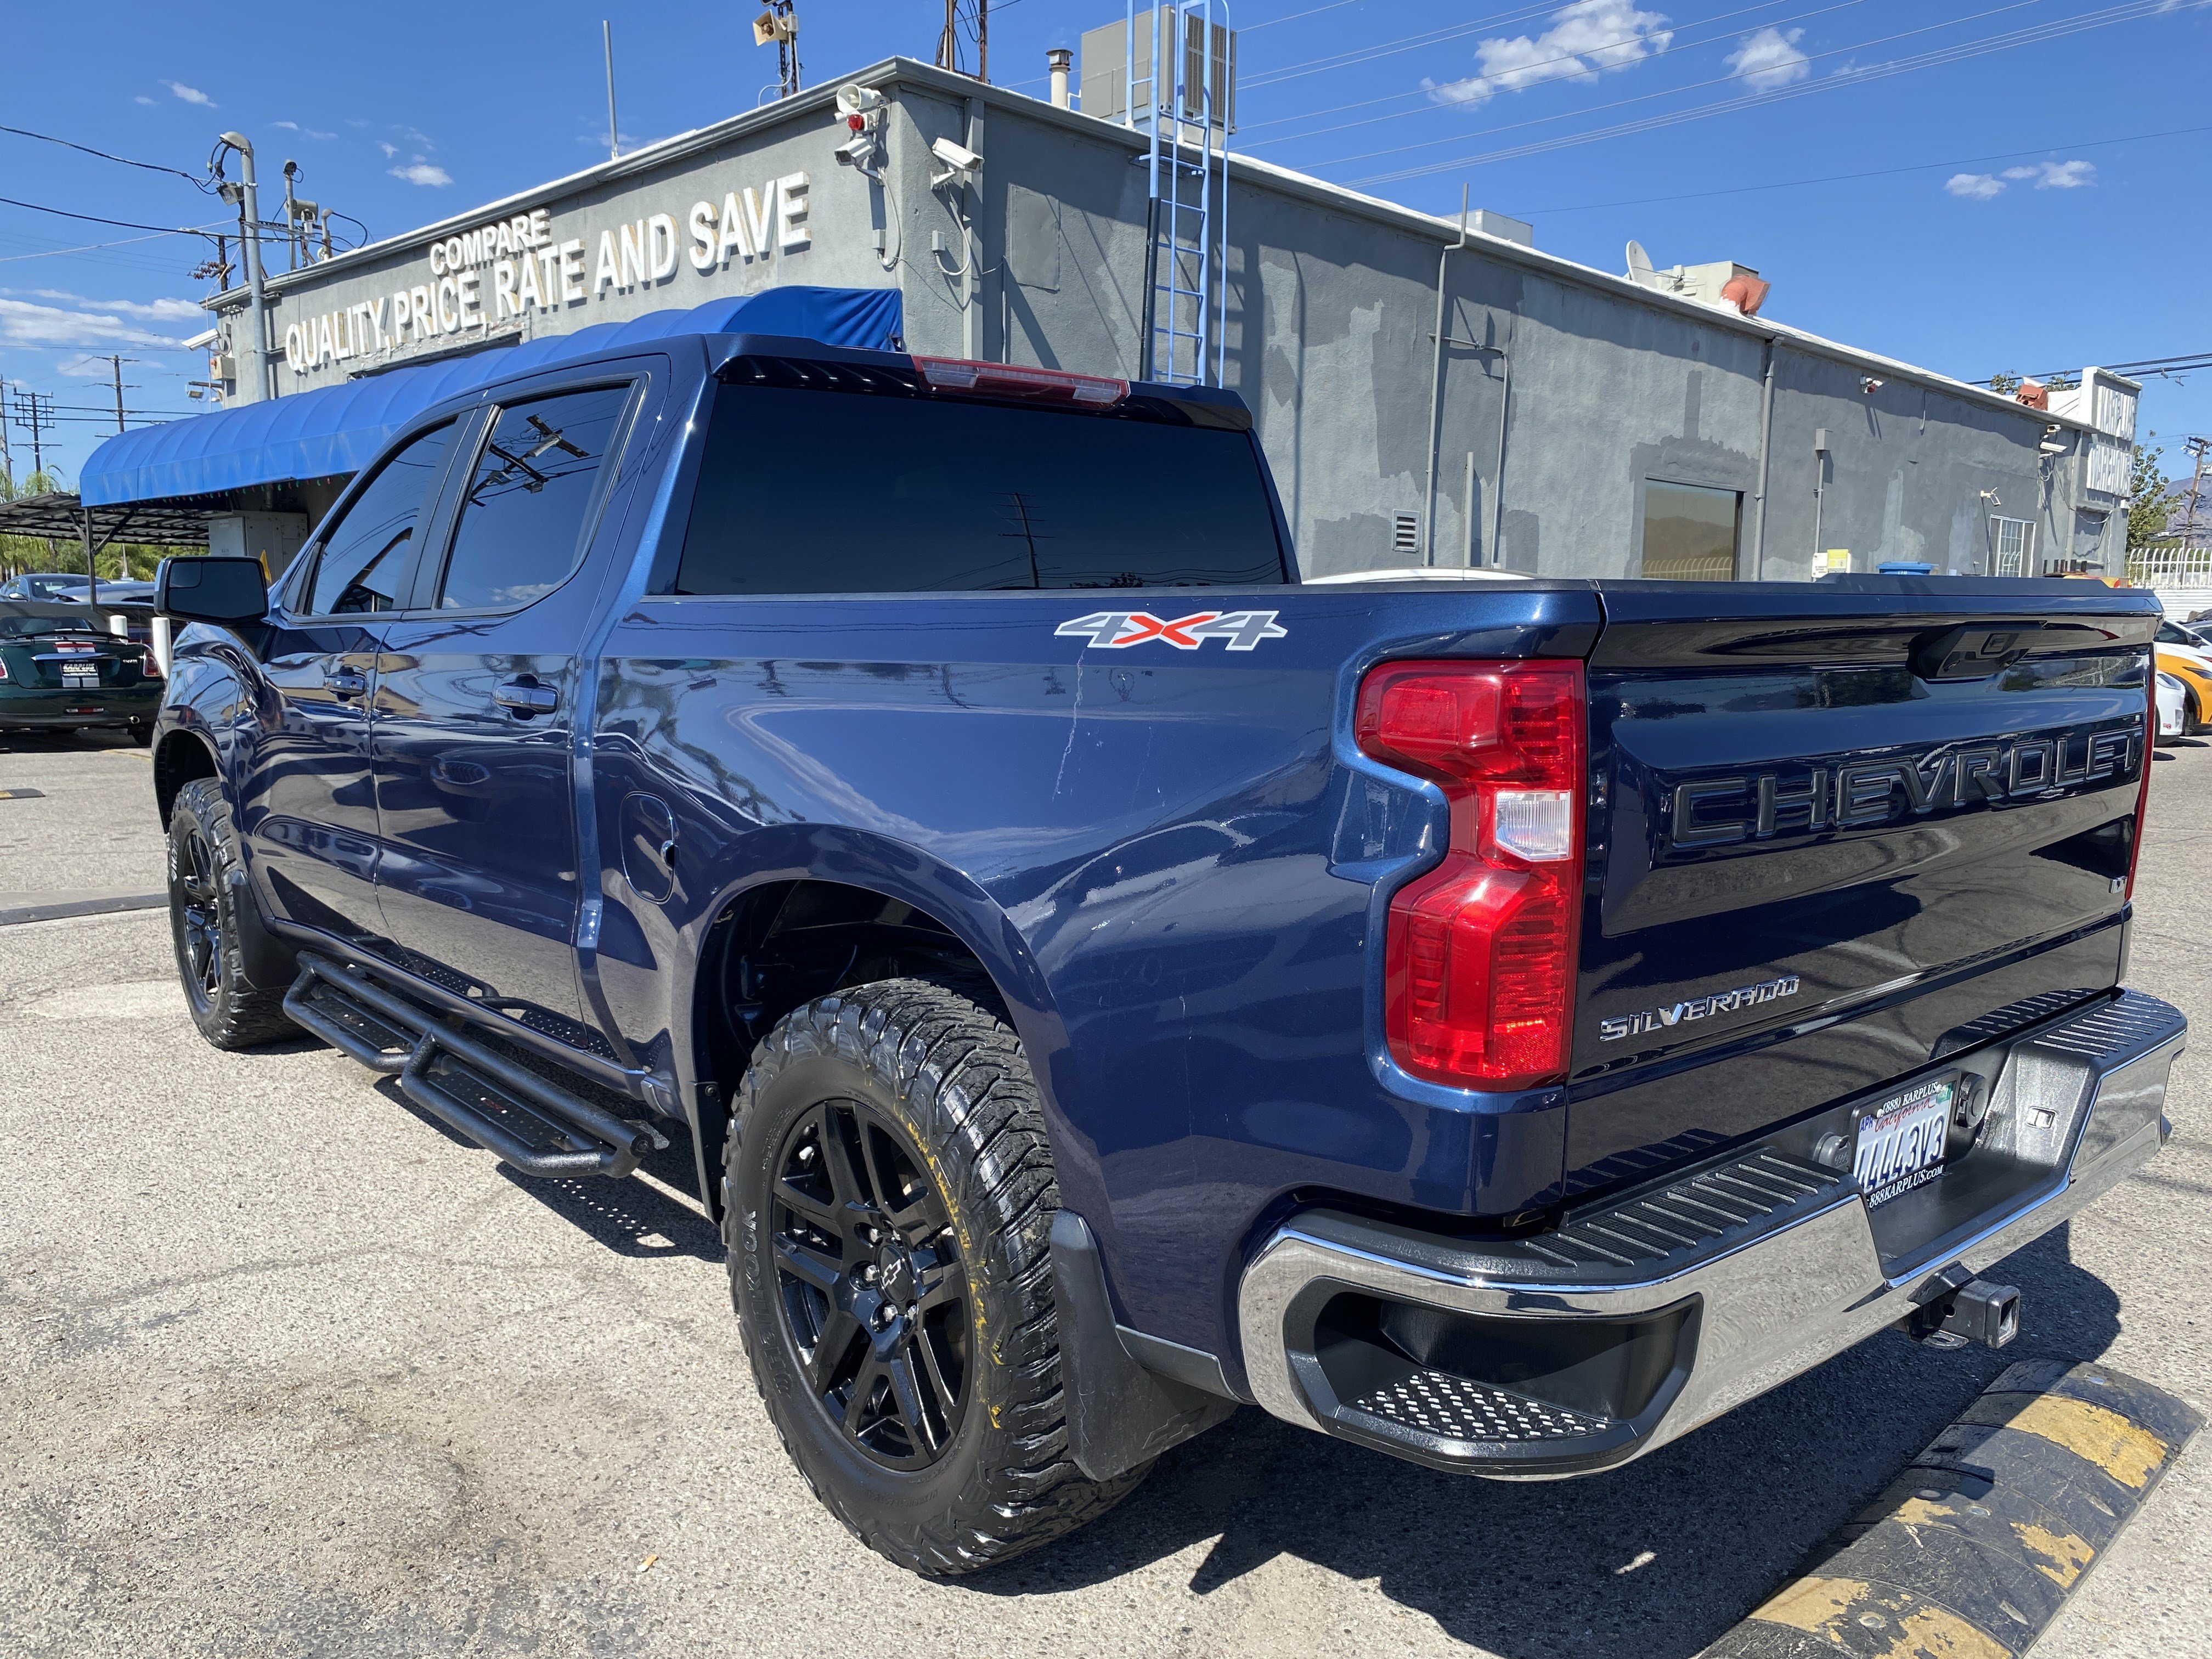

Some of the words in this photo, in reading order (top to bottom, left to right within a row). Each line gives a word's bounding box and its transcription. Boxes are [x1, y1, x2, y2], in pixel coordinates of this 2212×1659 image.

[430, 208, 551, 275] COMPARE
[494, 238, 588, 318] RATE
[594, 213, 680, 294] AND
[689, 171, 812, 269] SAVE
[1671, 724, 2143, 849] CHEVROLET
[1599, 974, 1800, 1042] SILVERADO
[1875, 1098, 1936, 1132] California
[1902, 1081, 1938, 1107] KARPLUS
